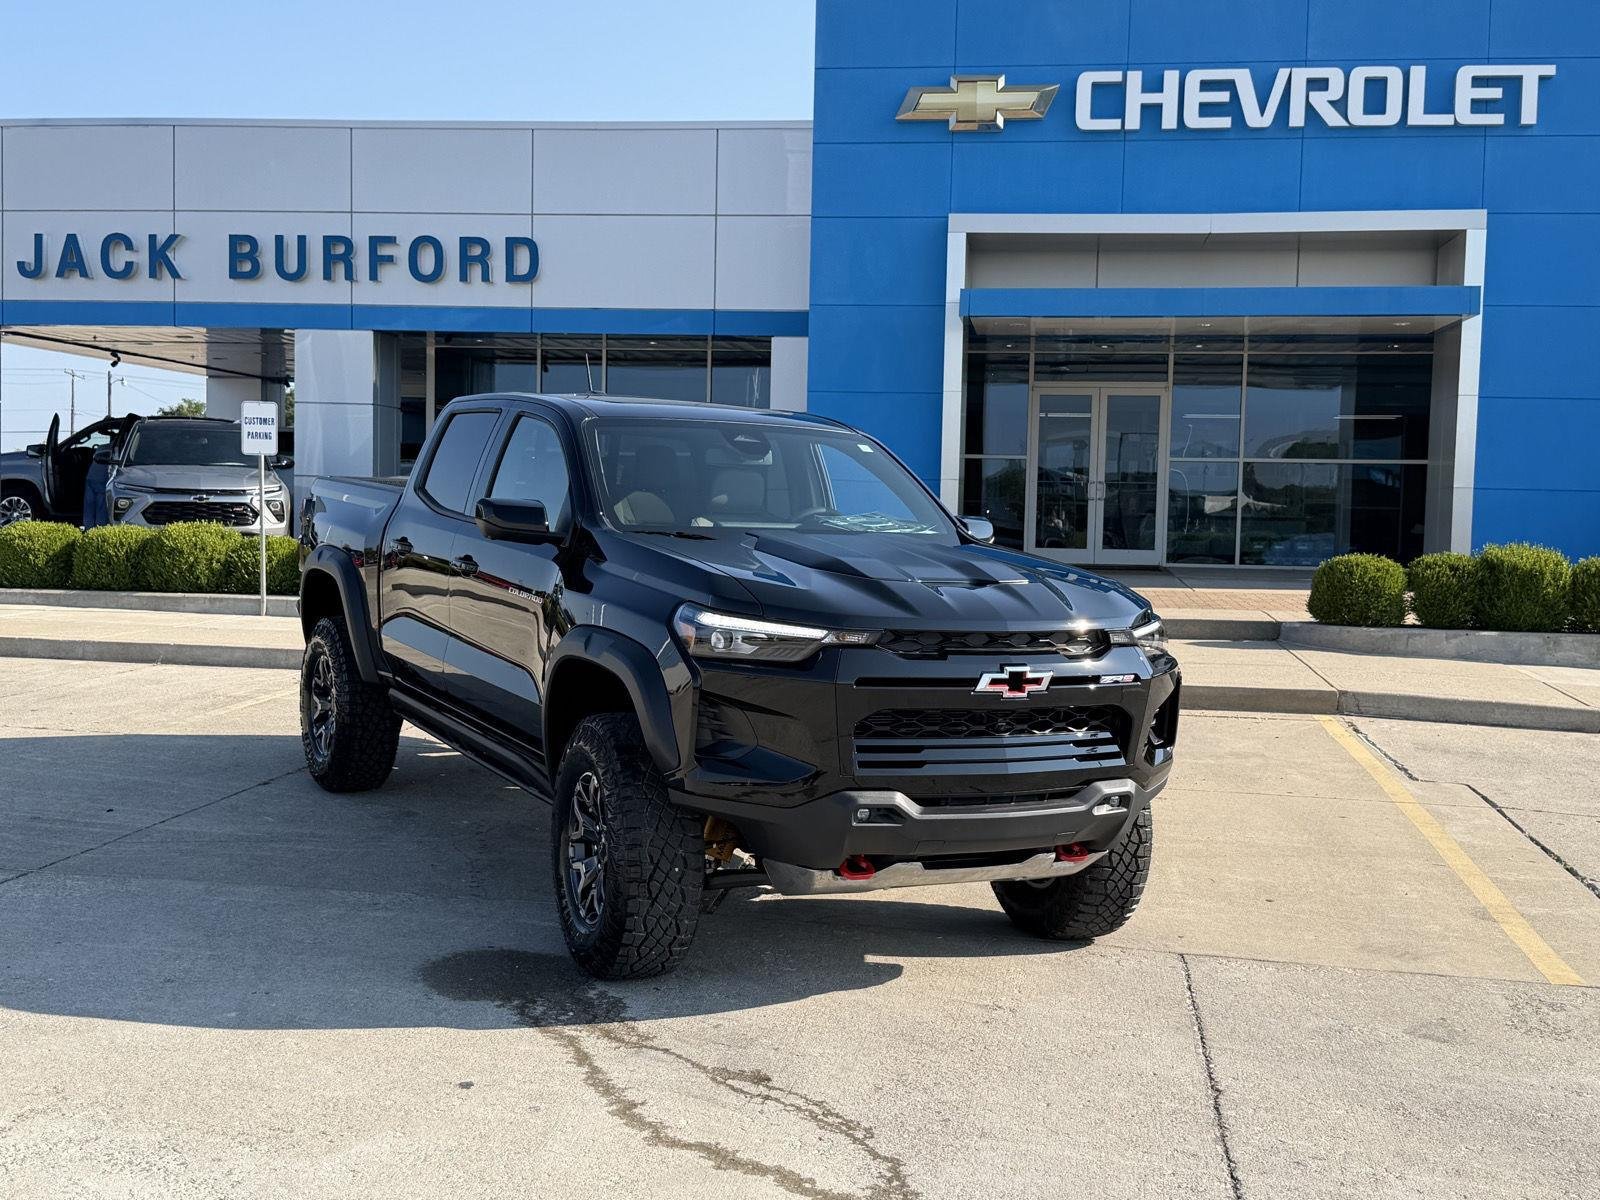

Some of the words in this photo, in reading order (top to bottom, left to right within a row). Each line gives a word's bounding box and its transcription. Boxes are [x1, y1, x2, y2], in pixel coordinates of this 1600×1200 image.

[1075, 64, 1556, 131] CHEVROLET
[17, 233, 183, 280] JACK
[228, 234, 540, 283] BURFORD
[244, 416, 275, 426] CUSTOMER
[247, 431, 272, 440] PARKING
